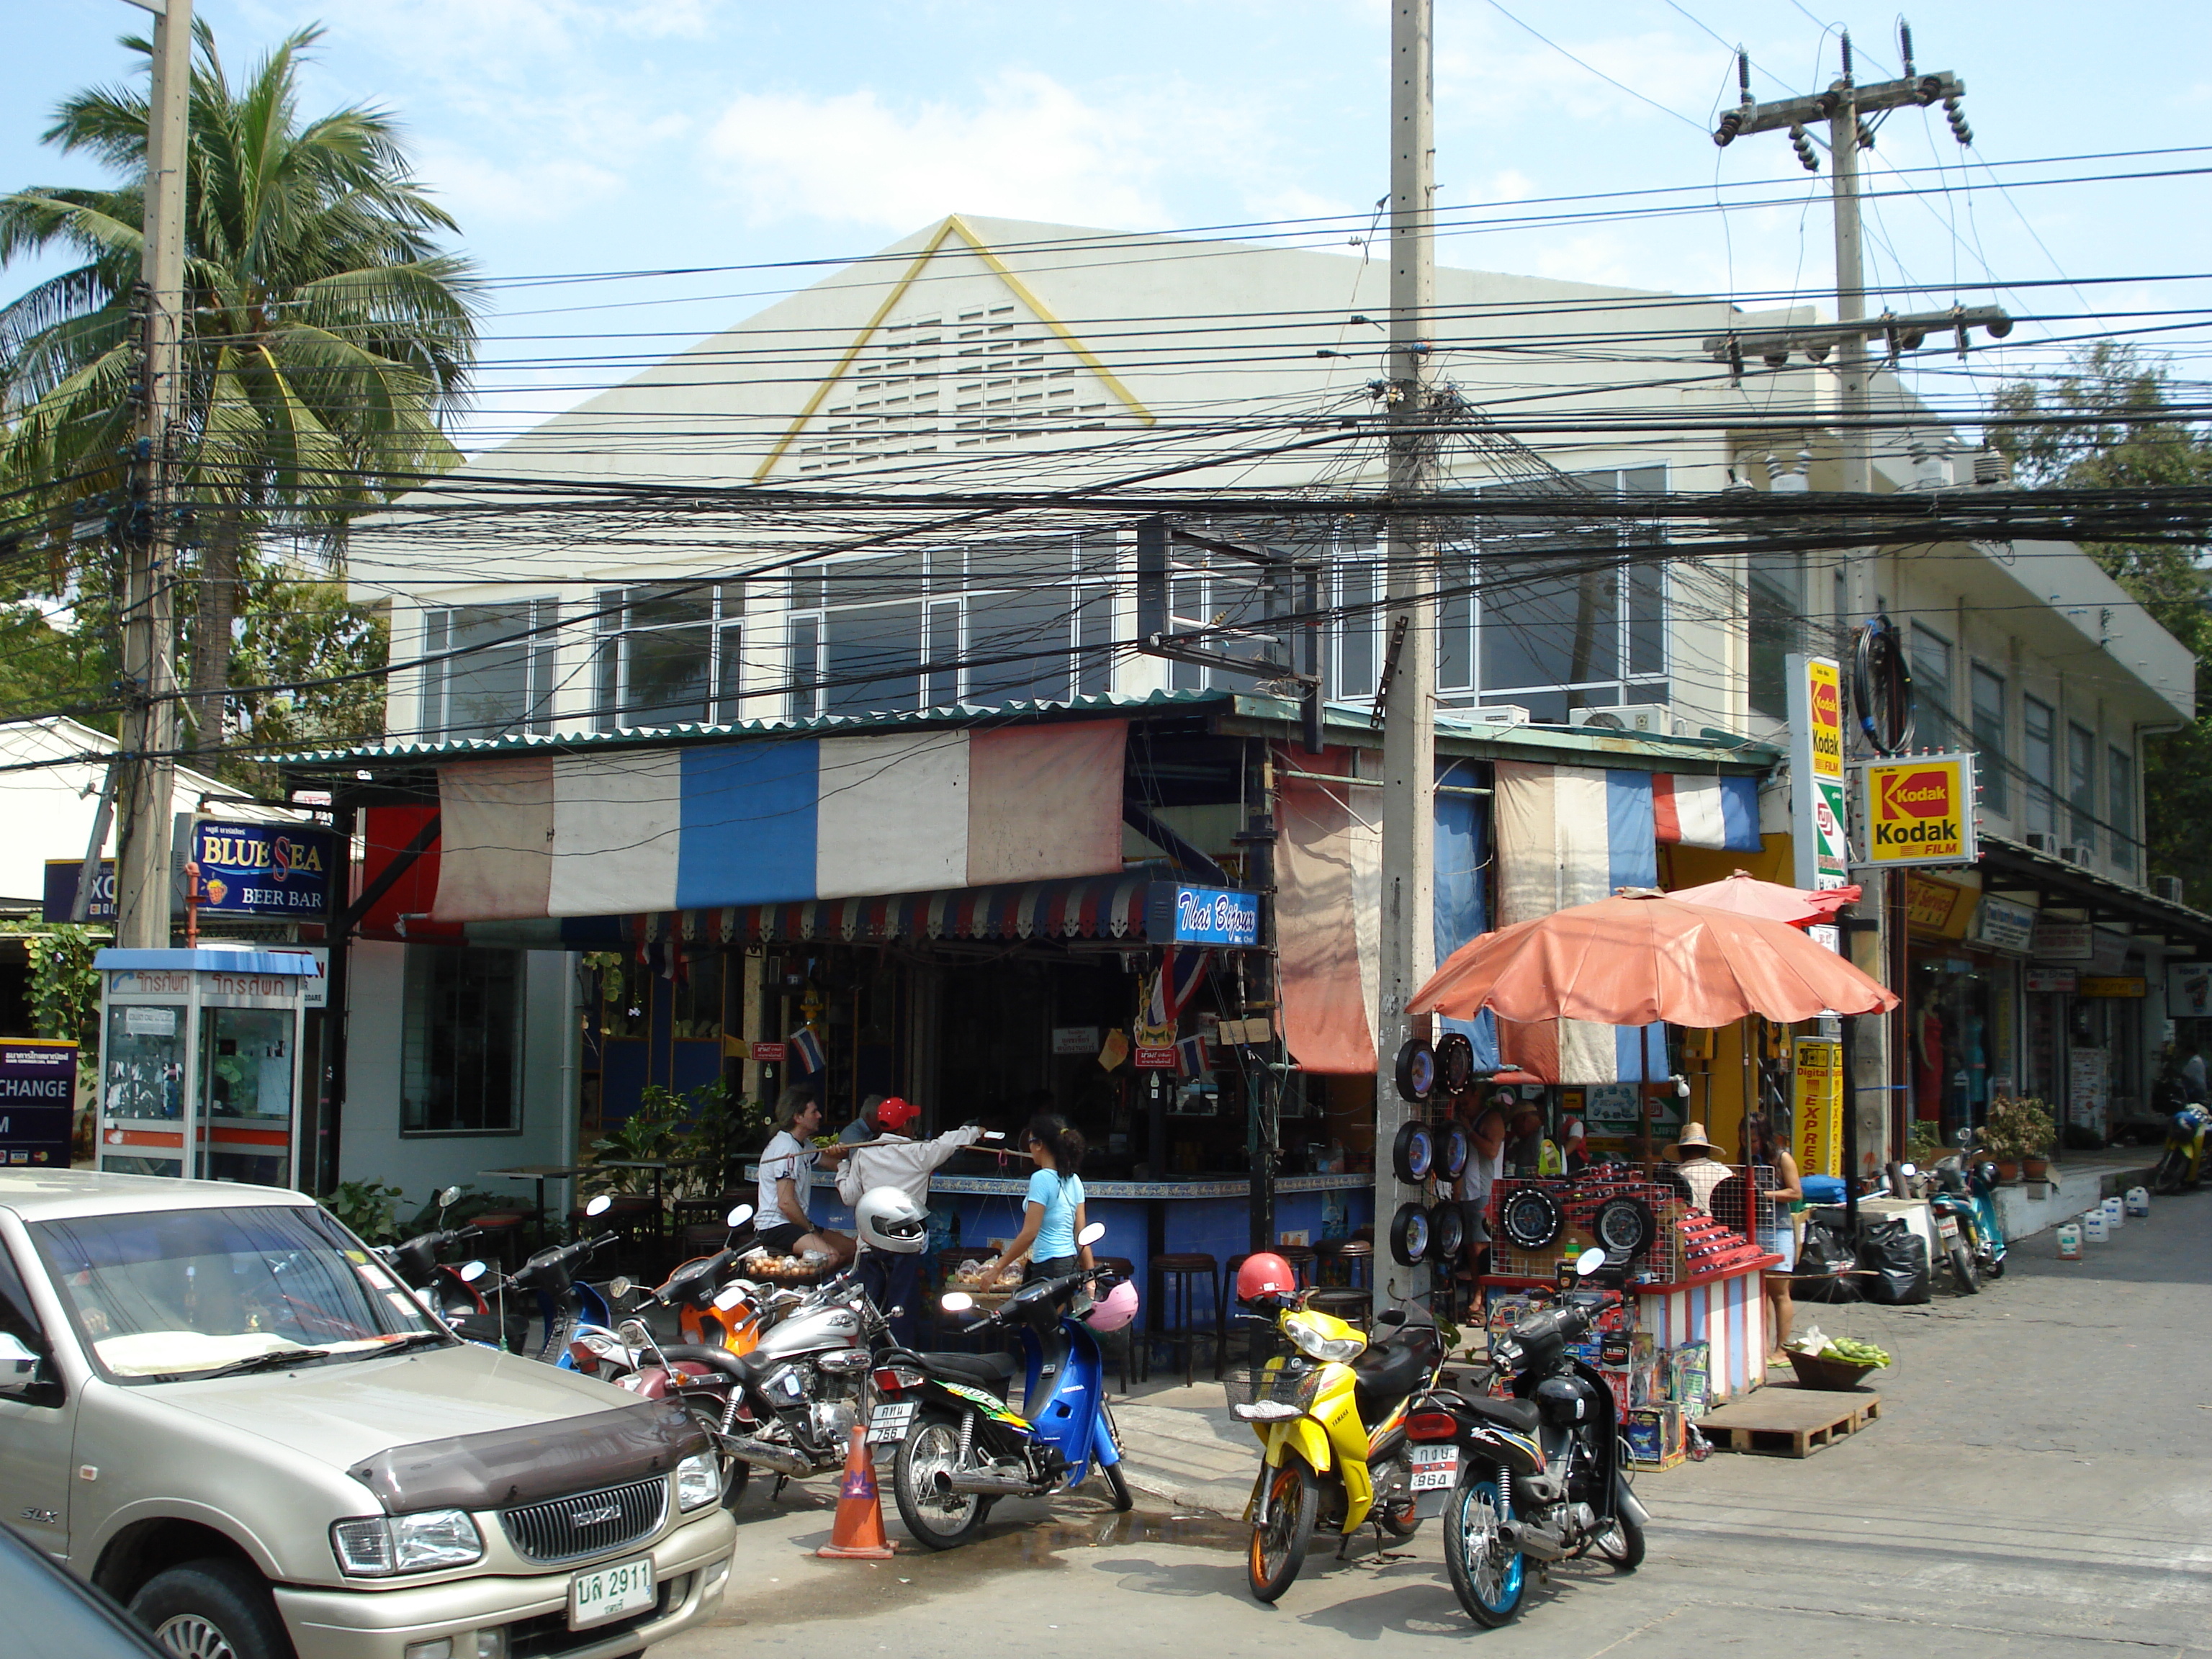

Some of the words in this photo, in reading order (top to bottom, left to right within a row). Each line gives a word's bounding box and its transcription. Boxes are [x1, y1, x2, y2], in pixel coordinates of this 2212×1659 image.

[1815, 695, 1837, 712] Kodak
[1813, 729, 1839, 757] Kodak
[1825, 761, 1838, 772] FILM
[1897, 786, 1946, 803] Kodak
[1876, 819, 1958, 845] Kodak
[1924, 843, 1957, 855] FILM
[202, 836, 270, 868] BLUE
[273, 836, 323, 882] SEA
[242, 887, 284, 906] BEER
[289, 891, 321, 908] BAR
[1178, 891, 1212, 931] Thai
[1215, 894, 1255, 941] Bijoux
[1797, 1067, 1828, 1078] Digital
[1331, 1408, 1349, 1427] YAMAHA
[878, 1428, 898, 1440] 756
[1419, 1474, 1447, 1486] 964
[21, 1506, 58, 1524] SLX
[573, 1504, 621, 1527] ISUZU
[609, 1563, 647, 1597] 2911
